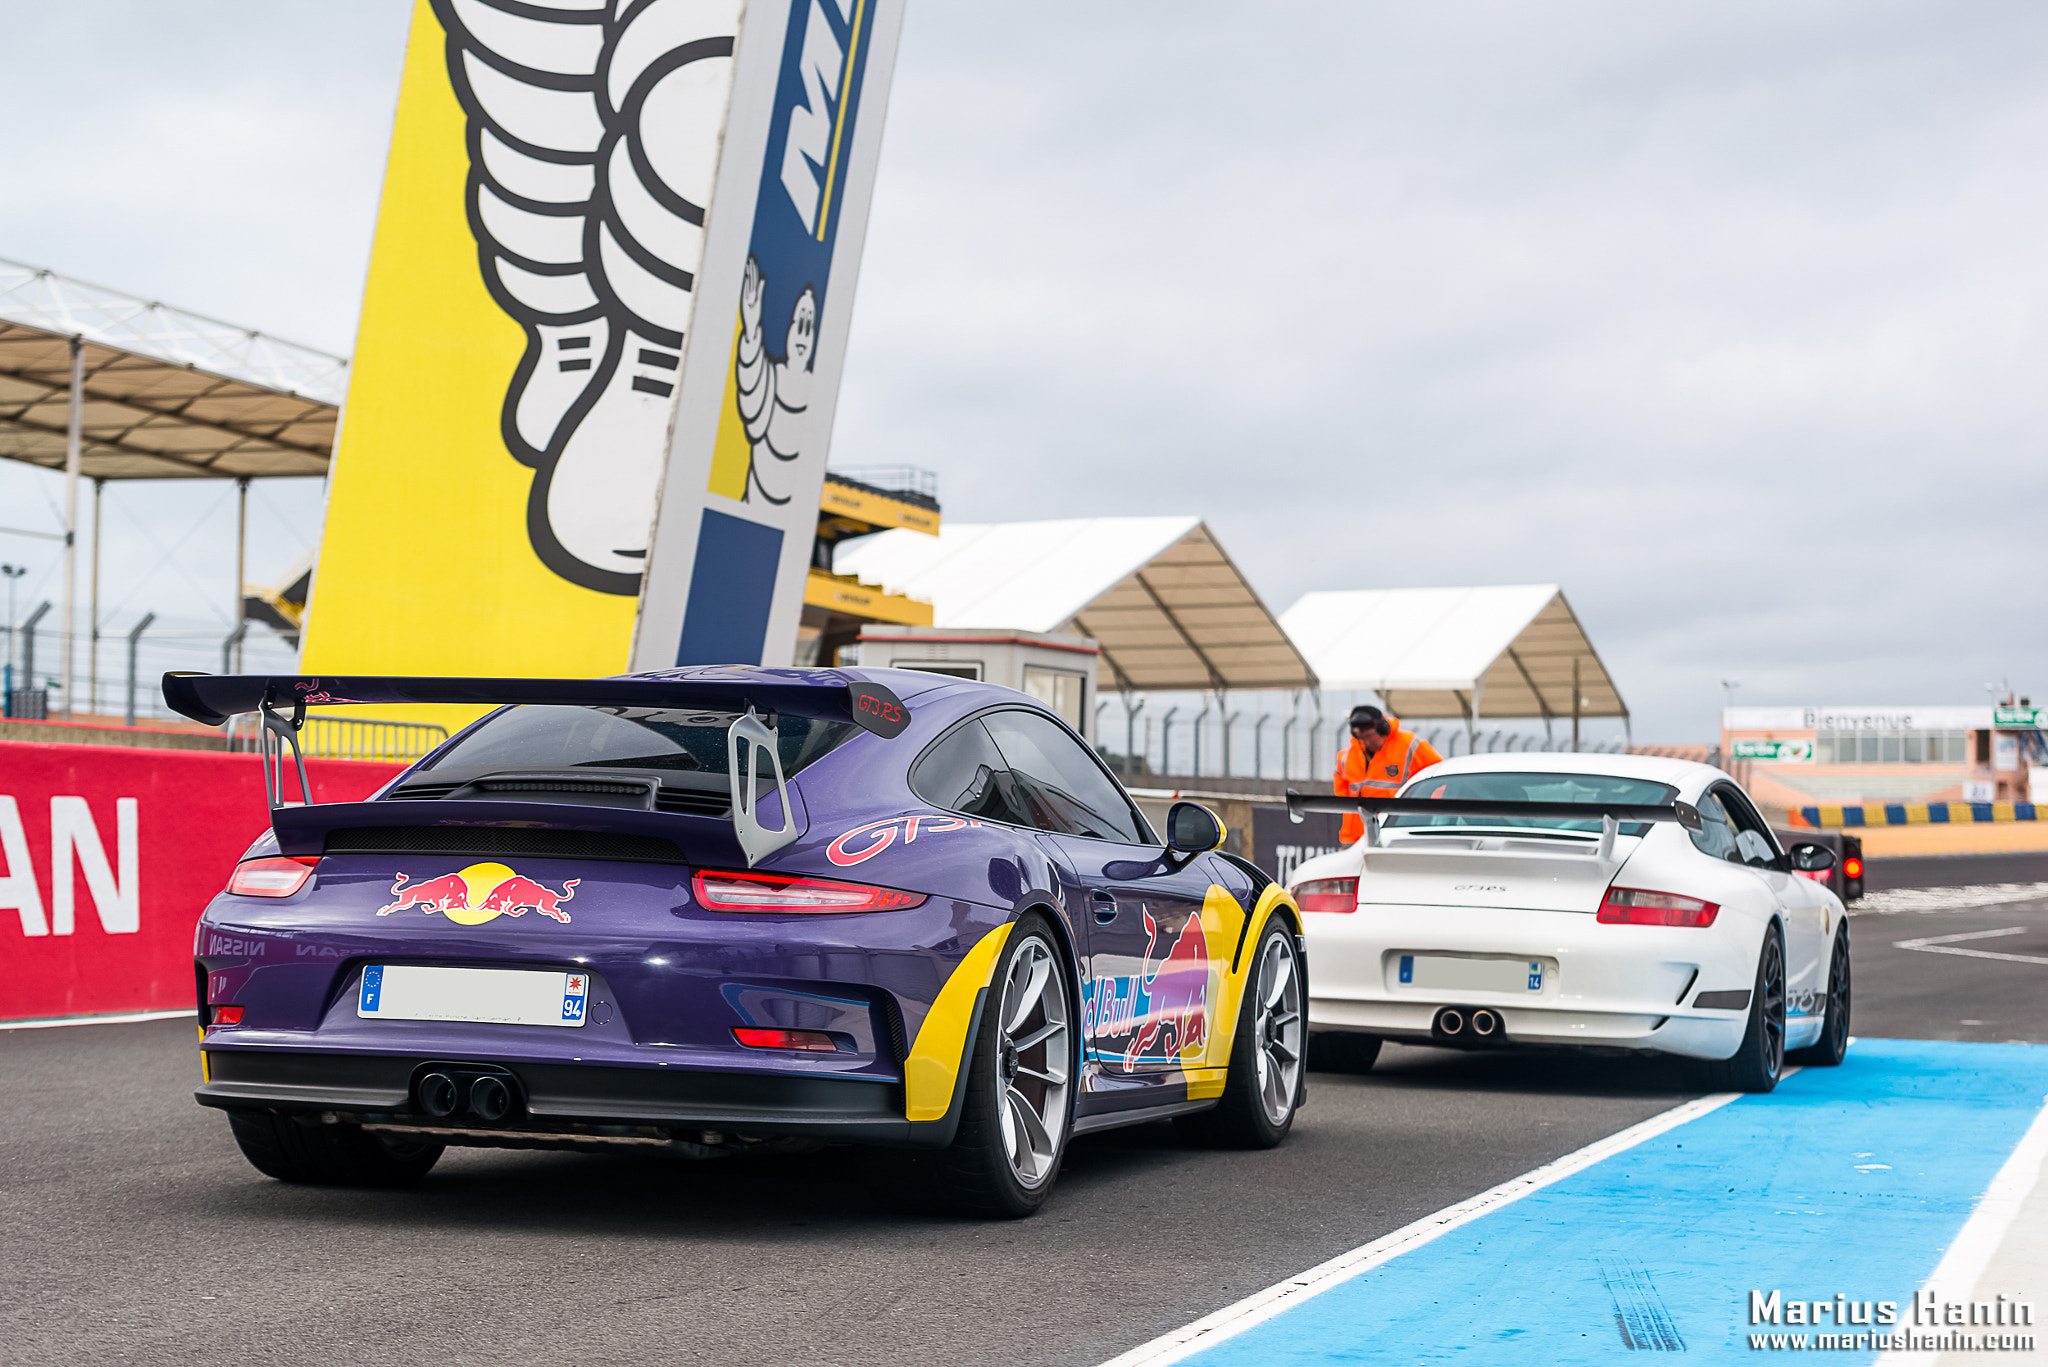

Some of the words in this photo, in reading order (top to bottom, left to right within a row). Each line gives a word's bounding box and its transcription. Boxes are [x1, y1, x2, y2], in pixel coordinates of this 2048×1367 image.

[1803, 707, 1913, 730] Bienvenue
[366, 993, 374, 1004] F
[563, 999, 582, 1017] 94
[1096, 975, 1140, 1039] Bull
